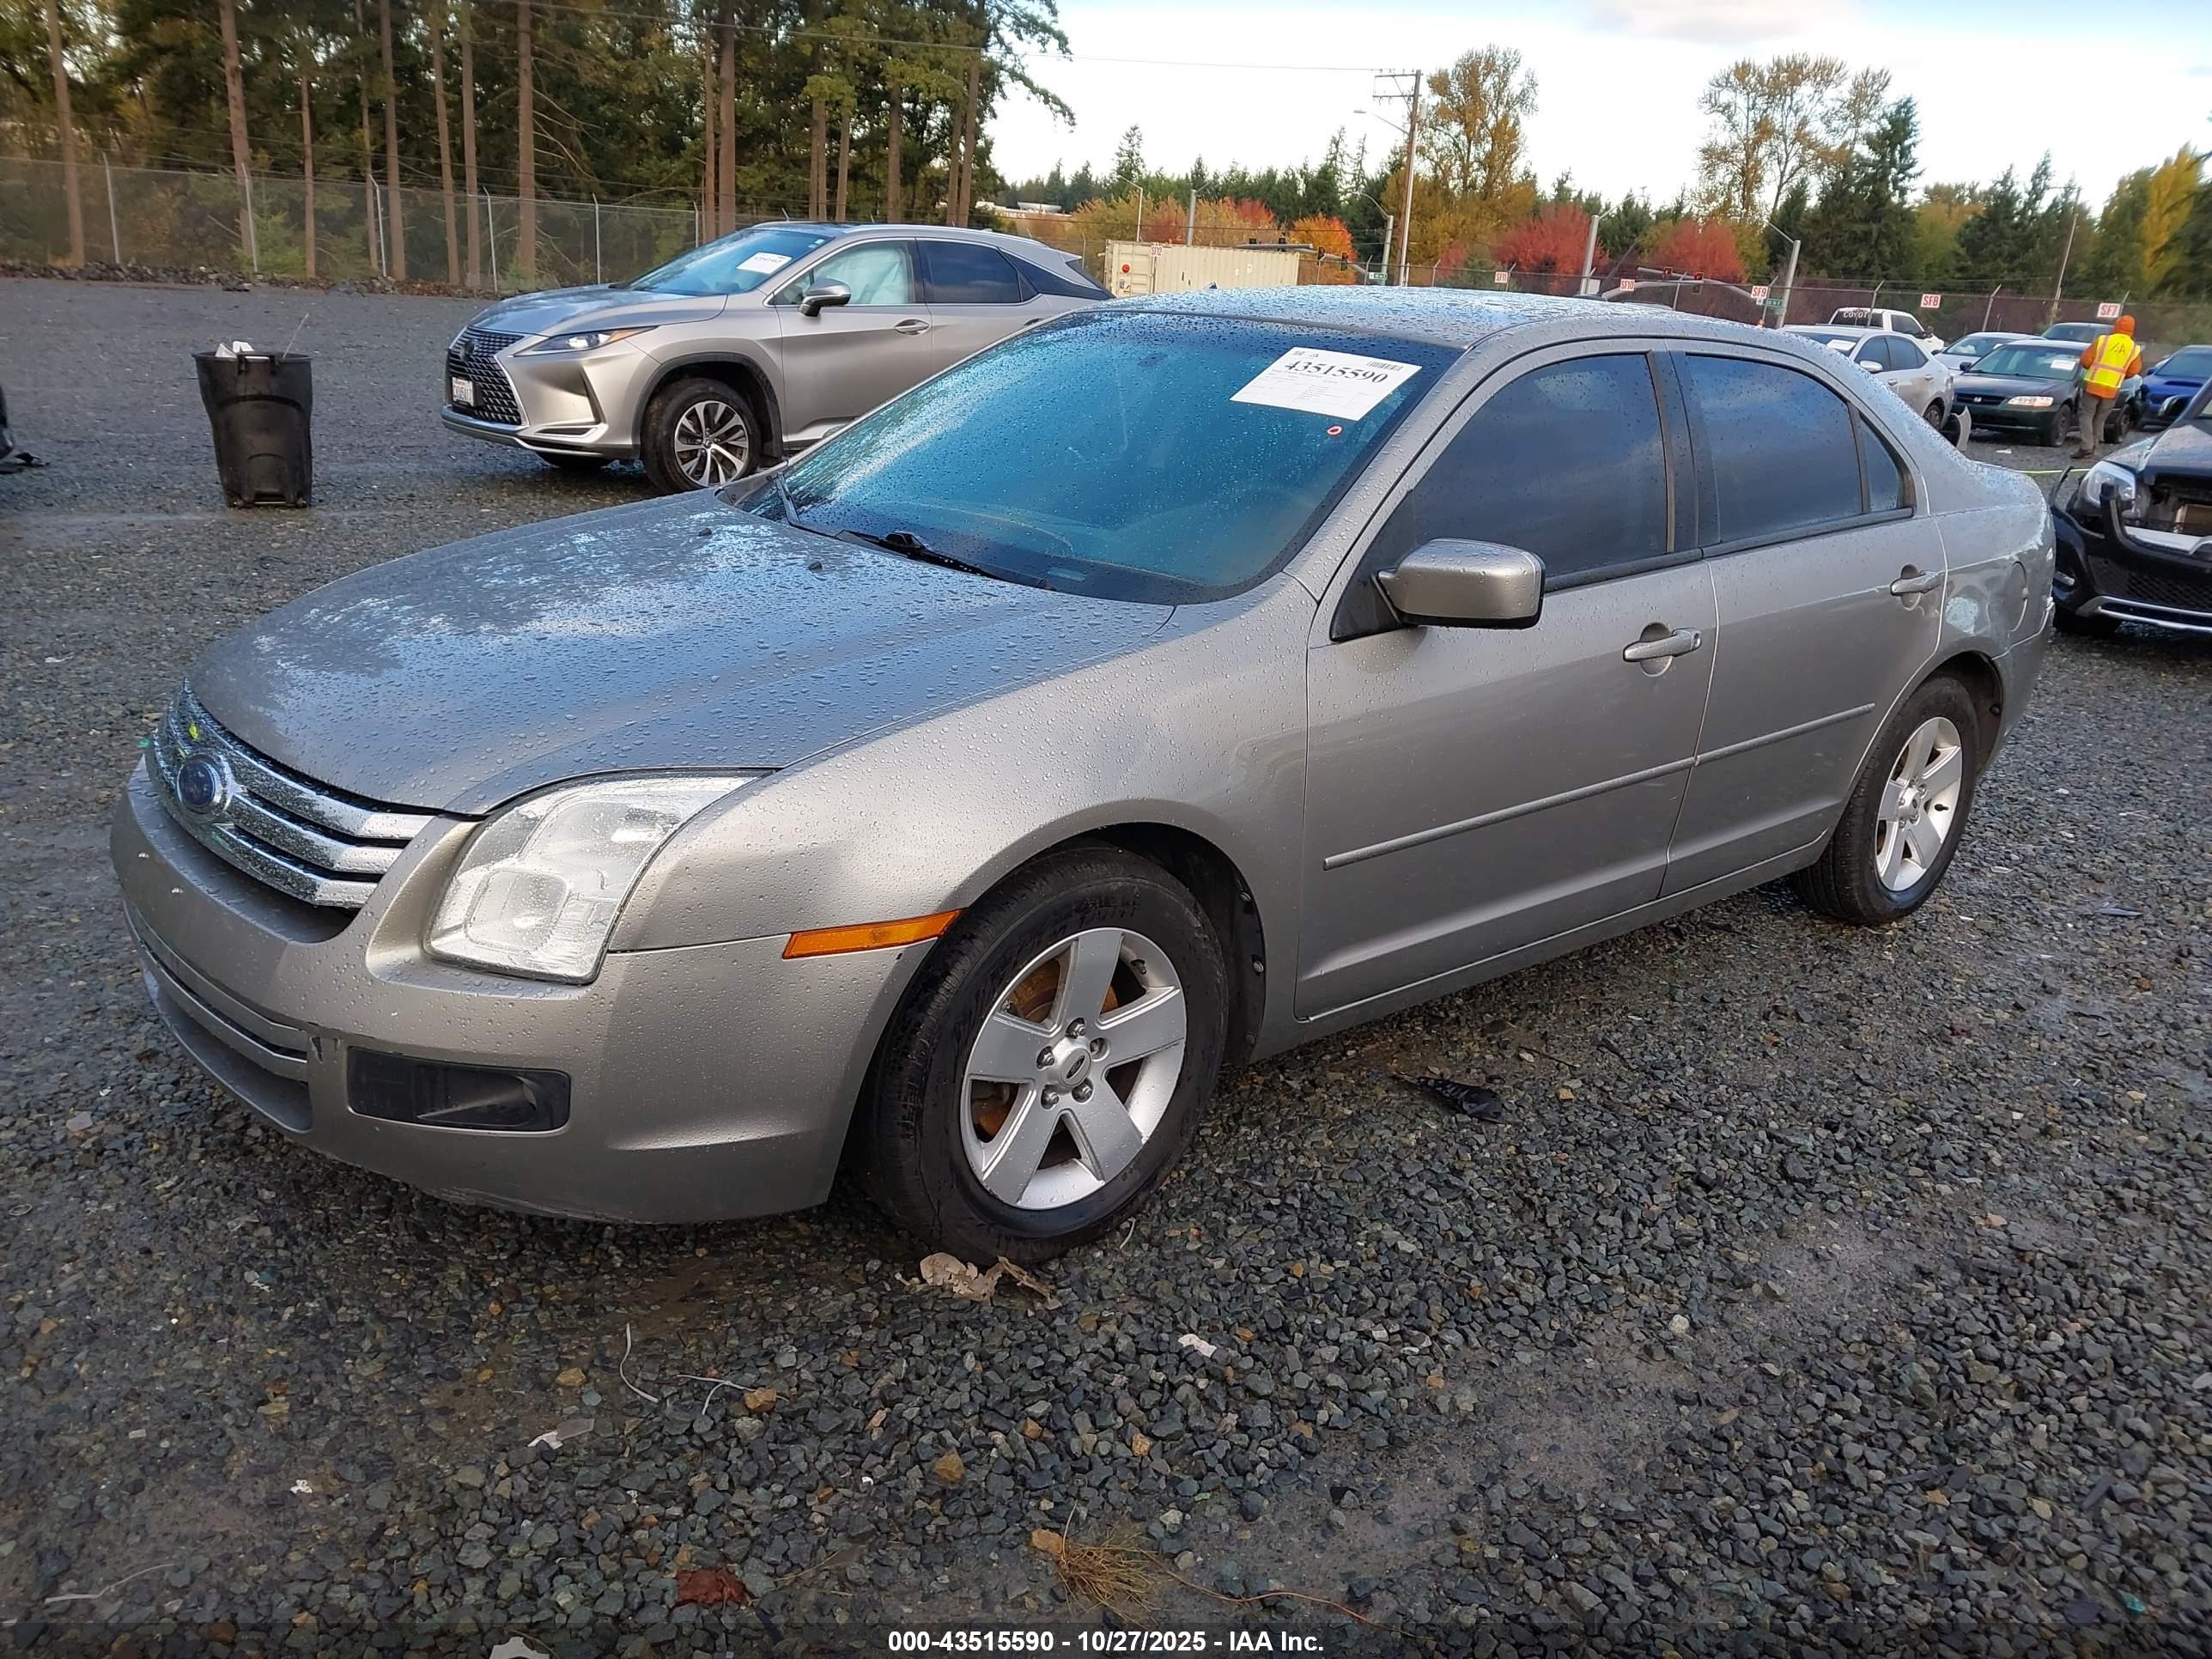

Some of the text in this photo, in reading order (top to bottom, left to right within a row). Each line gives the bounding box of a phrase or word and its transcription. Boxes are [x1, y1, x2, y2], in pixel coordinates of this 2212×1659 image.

[1496, 272, 1507, 282] SF11
[1620, 280, 1634, 289] SF10
[1752, 287, 1767, 297] SF9
[1923, 295, 1939, 307] SF8
[1843, 310, 1870, 319] COYOT
[2100, 304, 2118, 316] SF7
[1284, 360, 1389, 383] 43515590
